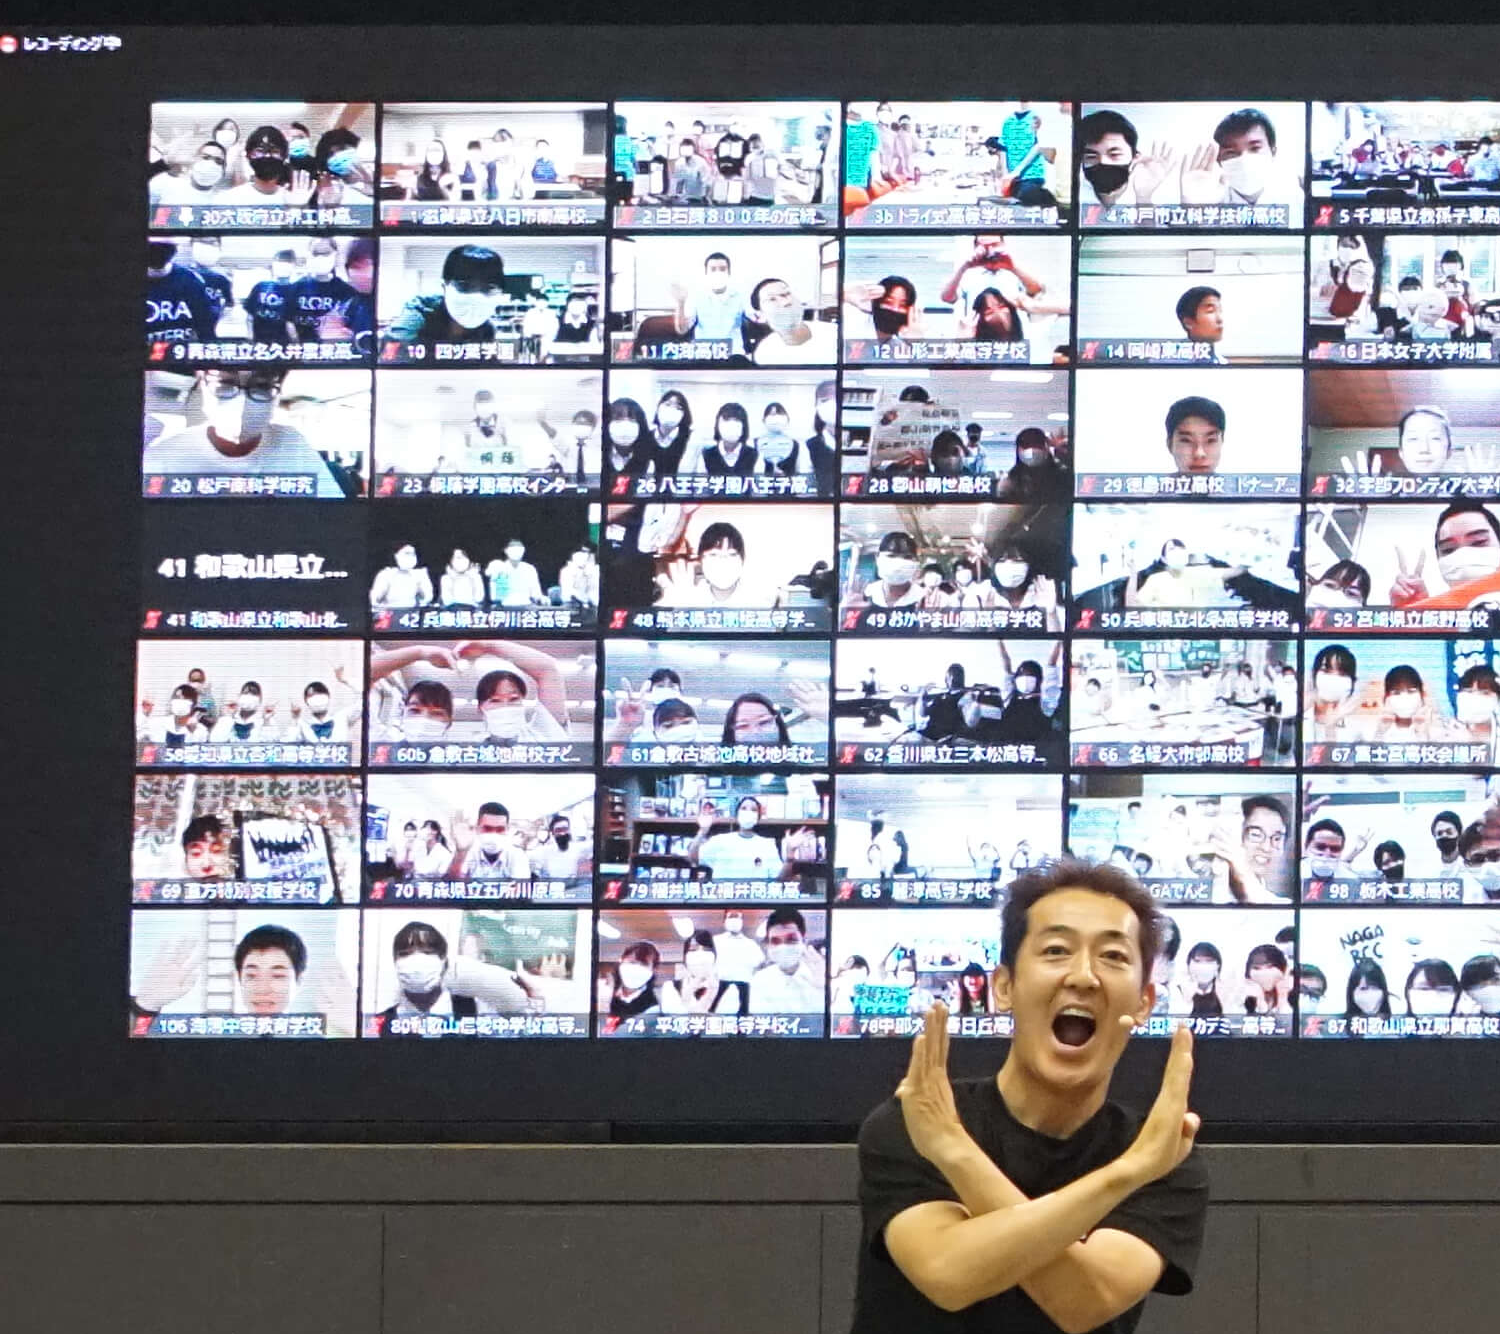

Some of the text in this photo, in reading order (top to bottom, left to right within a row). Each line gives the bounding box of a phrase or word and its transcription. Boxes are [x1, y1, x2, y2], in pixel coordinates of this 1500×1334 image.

[643, 210, 652, 224] 2
[1107, 208, 1286, 224] 4 神戸市立科学技術高校
[1340, 207, 1349, 224] 5
[174, 343, 185, 359] 9
[408, 343, 514, 359] 10 四ツ葉学園
[642, 343, 731, 359] 11 内海高校
[874, 343, 1026, 358] 12 山形工業高等学校
[1107, 342, 1211, 358] 14 岡崎東高校
[1340, 342, 1356, 358] 16
[1361, 342, 1492, 358] 日本女子大学附属
[171, 477, 312, 493] 20 松戸南科学研究
[404, 477, 423, 493] 23
[637, 477, 816, 493] 26 八王子学園八王子高...
[869, 476, 991, 493] 28 郡山萌世高校
[1103, 476, 1122, 492] 29
[1126, 476, 1224, 492] 徳島市立高校
[1336, 476, 1354, 493] 32
[157, 555, 348, 581] 41 和歌山県立...
[167, 611, 185, 628] 41
[399, 611, 419, 627] 42
[633, 611, 653, 627] 48
[866, 611, 1042, 627] 49 おかやま山陽高等学校
[1101, 611, 1288, 627] 50 兵庫県立北条高等学校
[1333, 611, 1353, 627] 52
[864, 746, 1046, 762] 62 香川県立三本松高等...
[1099, 745, 1118, 762] 66
[1332, 745, 1486, 762] 67 富士宮高校会議所
[162, 883, 181, 900] 69
[395, 882, 414, 898] 70
[629, 882, 648, 899] 79
[861, 882, 881, 899] 85
[1330, 882, 1460, 899] 98 栃木工業高校
[160, 1017, 186, 1034] 106
[627, 1017, 645, 1033] 74
[1327, 1017, 1347, 1034] 87
